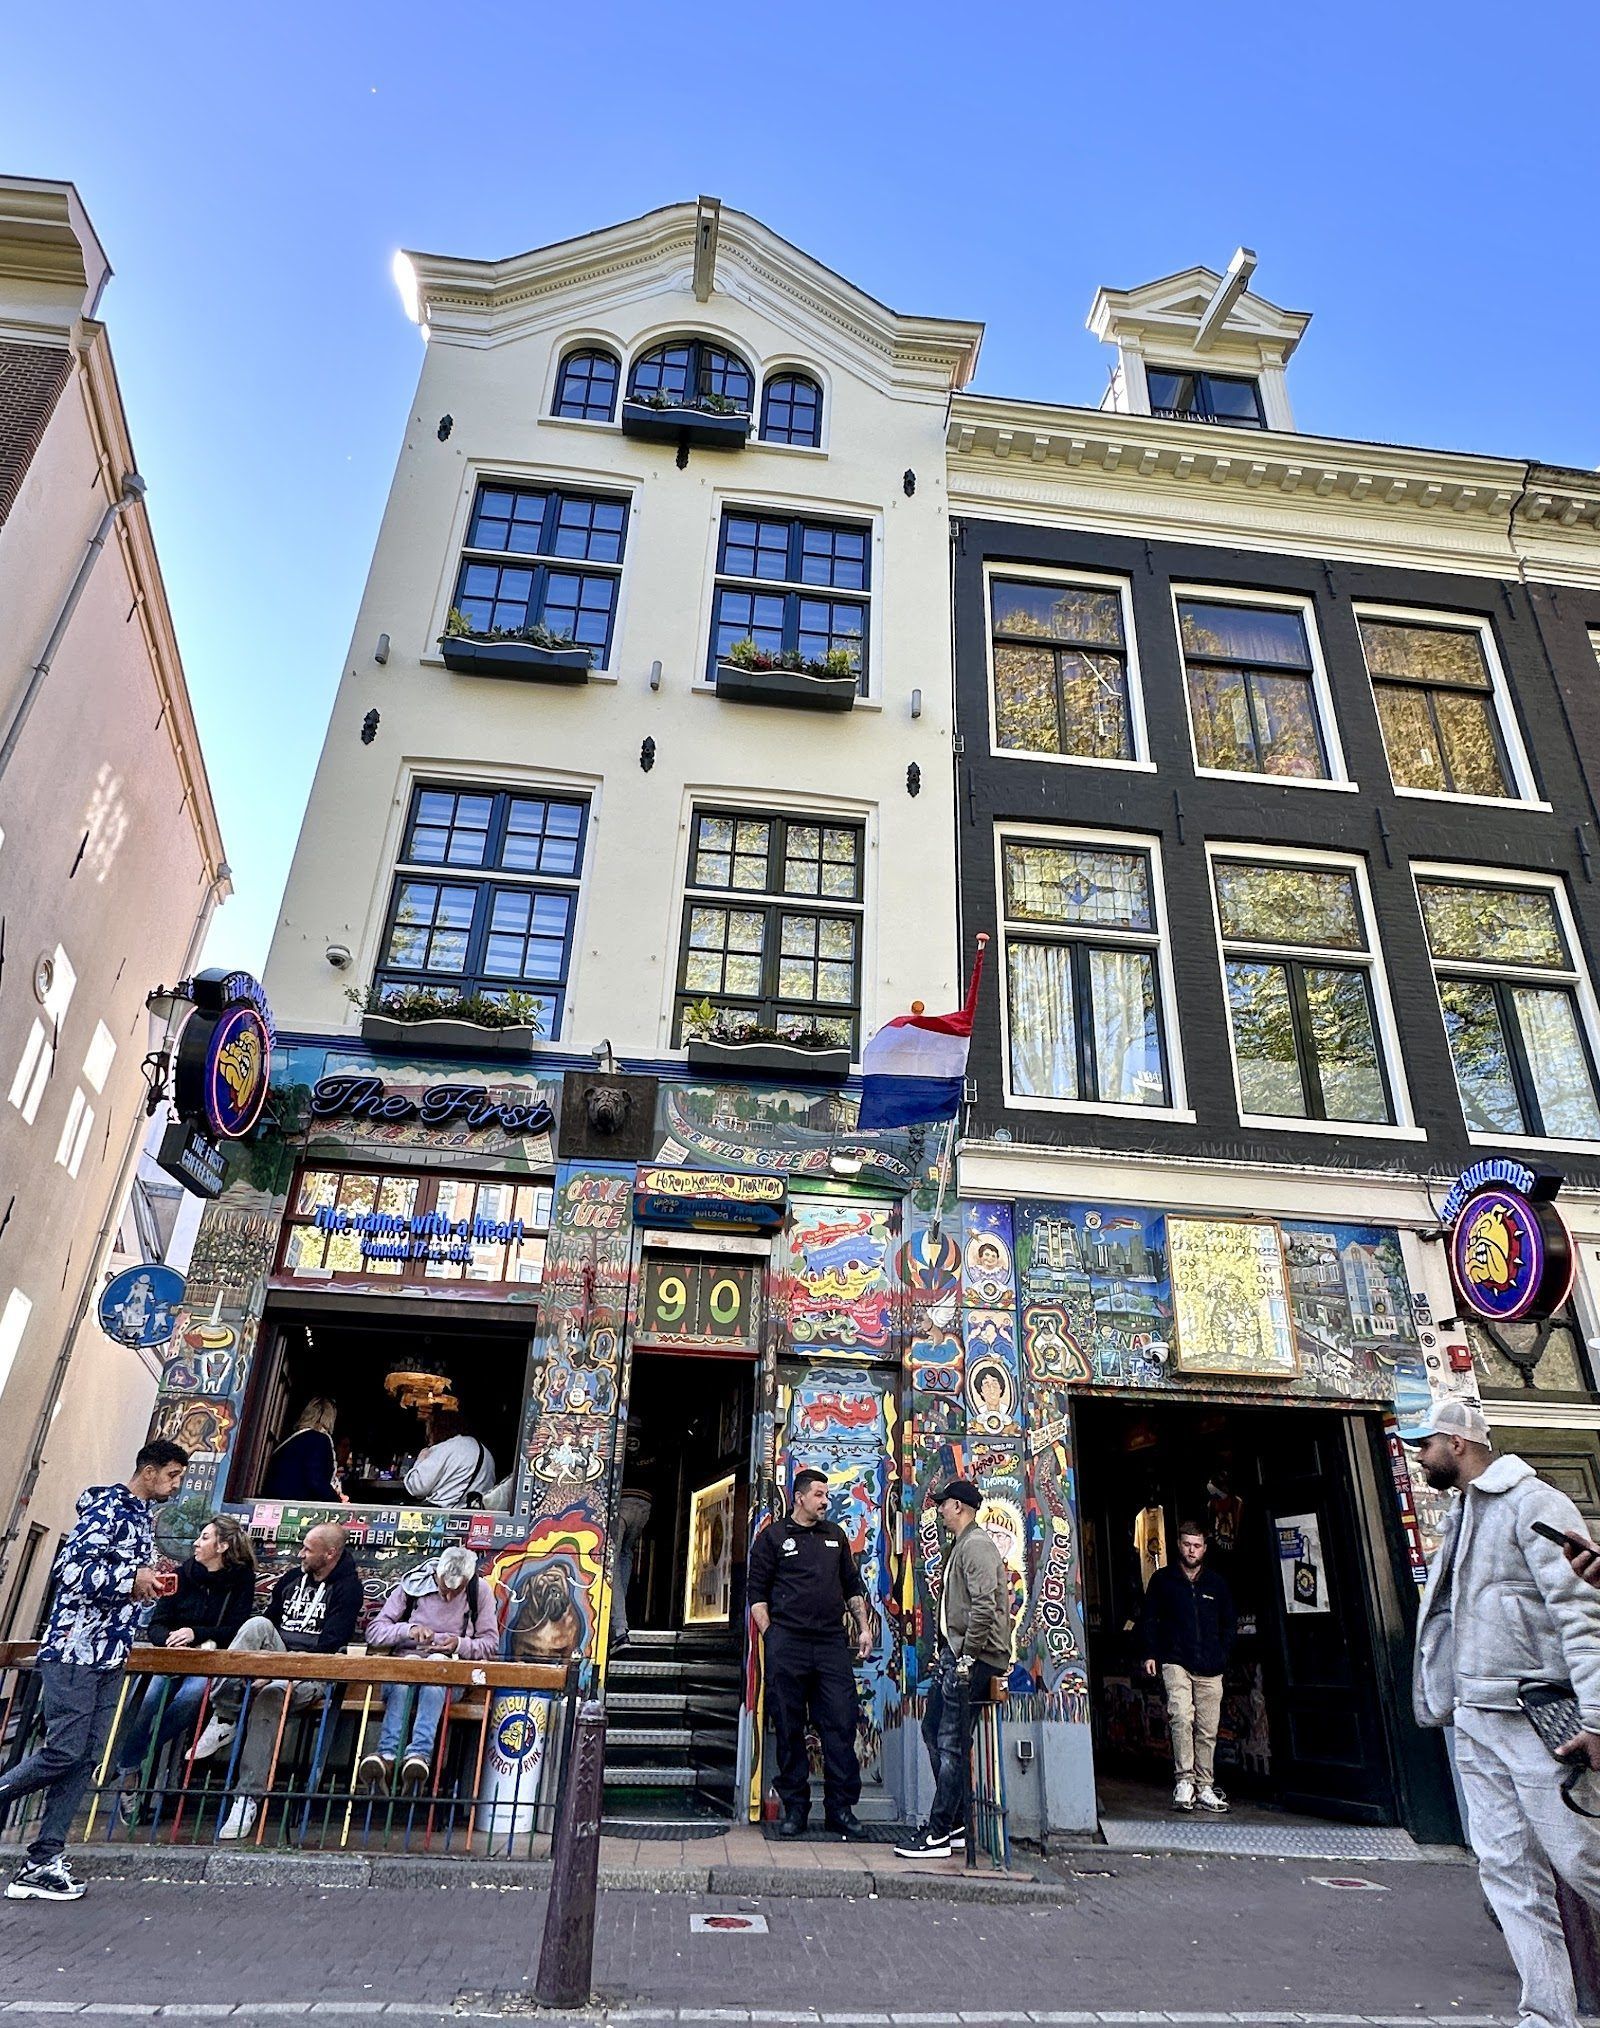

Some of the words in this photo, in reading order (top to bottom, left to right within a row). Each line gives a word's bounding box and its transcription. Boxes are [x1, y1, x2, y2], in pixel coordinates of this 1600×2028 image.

[311, 1076, 414, 1117] The
[419, 1083, 552, 1130] First
[774, 1145, 910, 1175] LEIDPLEIN
[1460, 1158, 1536, 1194] BULLDOG
[566, 1179, 633, 1203] ORANGE
[315, 1204, 348, 1229] The
[352, 1212, 404, 1233] name
[411, 1210, 451, 1237] with
[456, 1218, 469, 1238] a
[473, 1213, 525, 1240] heart
[561, 1202, 626, 1229] JUICE
[360, 1239, 409, 1258] Founded
[656, 1276, 741, 1324] 90
[923, 1368, 953, 1389] 90
[1041, 1515, 1076, 1652] BULLDOG
